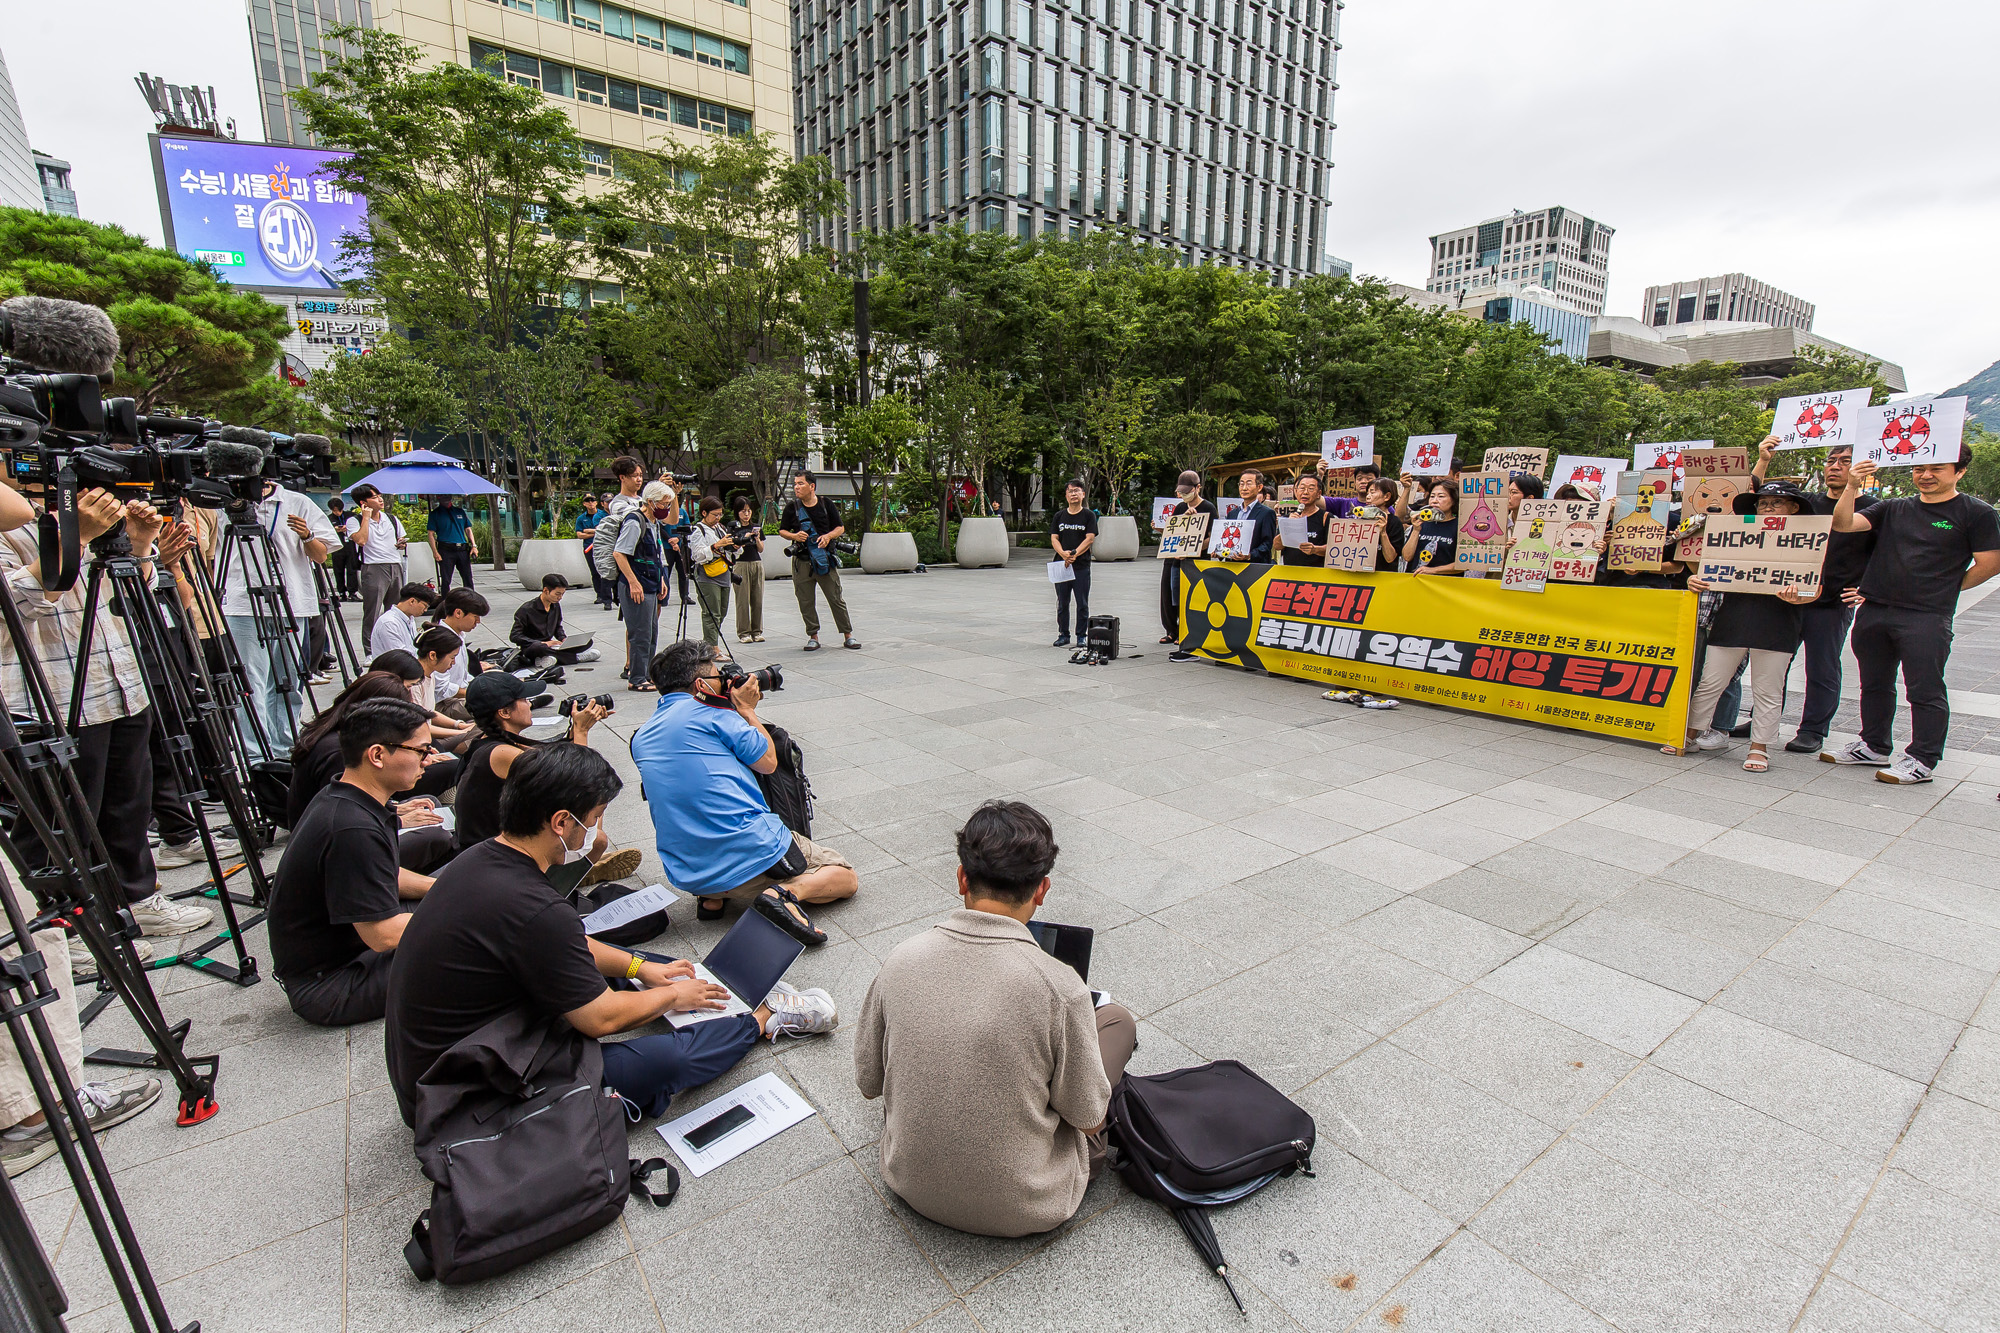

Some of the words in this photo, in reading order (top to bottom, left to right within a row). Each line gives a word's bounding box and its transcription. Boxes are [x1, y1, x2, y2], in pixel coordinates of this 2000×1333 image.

[180, 169, 227, 196] 수능!
[232, 172, 310, 201] 서울런과
[234, 204, 256, 229] 잘
[296, 319, 380, 335] 강비뇨기과
[88, 461, 113, 473] SONY
[1683, 454, 1745, 474] 해양투기
[1463, 477, 1504, 496] 바다
[63, 489, 72, 513] SONY
[1521, 502, 1558, 518] 오염수
[1566, 502, 1600, 521] 방류
[1166, 515, 1205, 534] 육지에
[1331, 522, 1378, 544] 멈춰라
[1613, 525, 1666, 540] 오염수방류
[1761, 516, 1787, 531] 왜
[1160, 534, 1202, 553] 보관하라
[1706, 531, 1766, 549] 바다에
[1776, 532, 1829, 551] 버려?
[1327, 546, 1369, 569] 오염수
[1458, 552, 1503, 565] 아니다
[1513, 549, 1530, 563] 투기
[1610, 544, 1663, 566] 중단하라
[1504, 567, 1547, 584] 중단하라
[1701, 564, 1768, 583] 보관하면
[1769, 569, 1819, 586] 되는데!
[1263, 581, 1372, 622] 멈춰라!
[1090, 638, 1111, 647] MIPRO
[1478, 627, 1551, 647] 환경운동연합
[1553, 635, 1581, 651] 전국
[1583, 639, 1613, 653] 동시
[1615, 642, 1677, 661] 기자회견
[1256, 618, 1362, 660] 후쿠시마
[1365, 633, 1464, 673] 오염수
[1470, 646, 1553, 687] 해양
[1559, 657, 1673, 704] 투기!
[1302, 663, 1322, 673] 2023년
[1323, 668, 1333, 676] 8월
[1334, 670, 1348, 679] 24일
[1349, 672, 1361, 682] 오전
[1363, 675, 1378, 684] 11시
[1391, 679, 1407, 689] 장소
[1414, 683, 1436, 694] 광화문
[1437, 687, 1460, 699] 이순신
[1461, 691, 1477, 702] 동상
[1478, 694, 1488, 704] 앞
[1507, 699, 1525, 710] 주최
[1594, 713, 1657, 732] 환경운동연합
